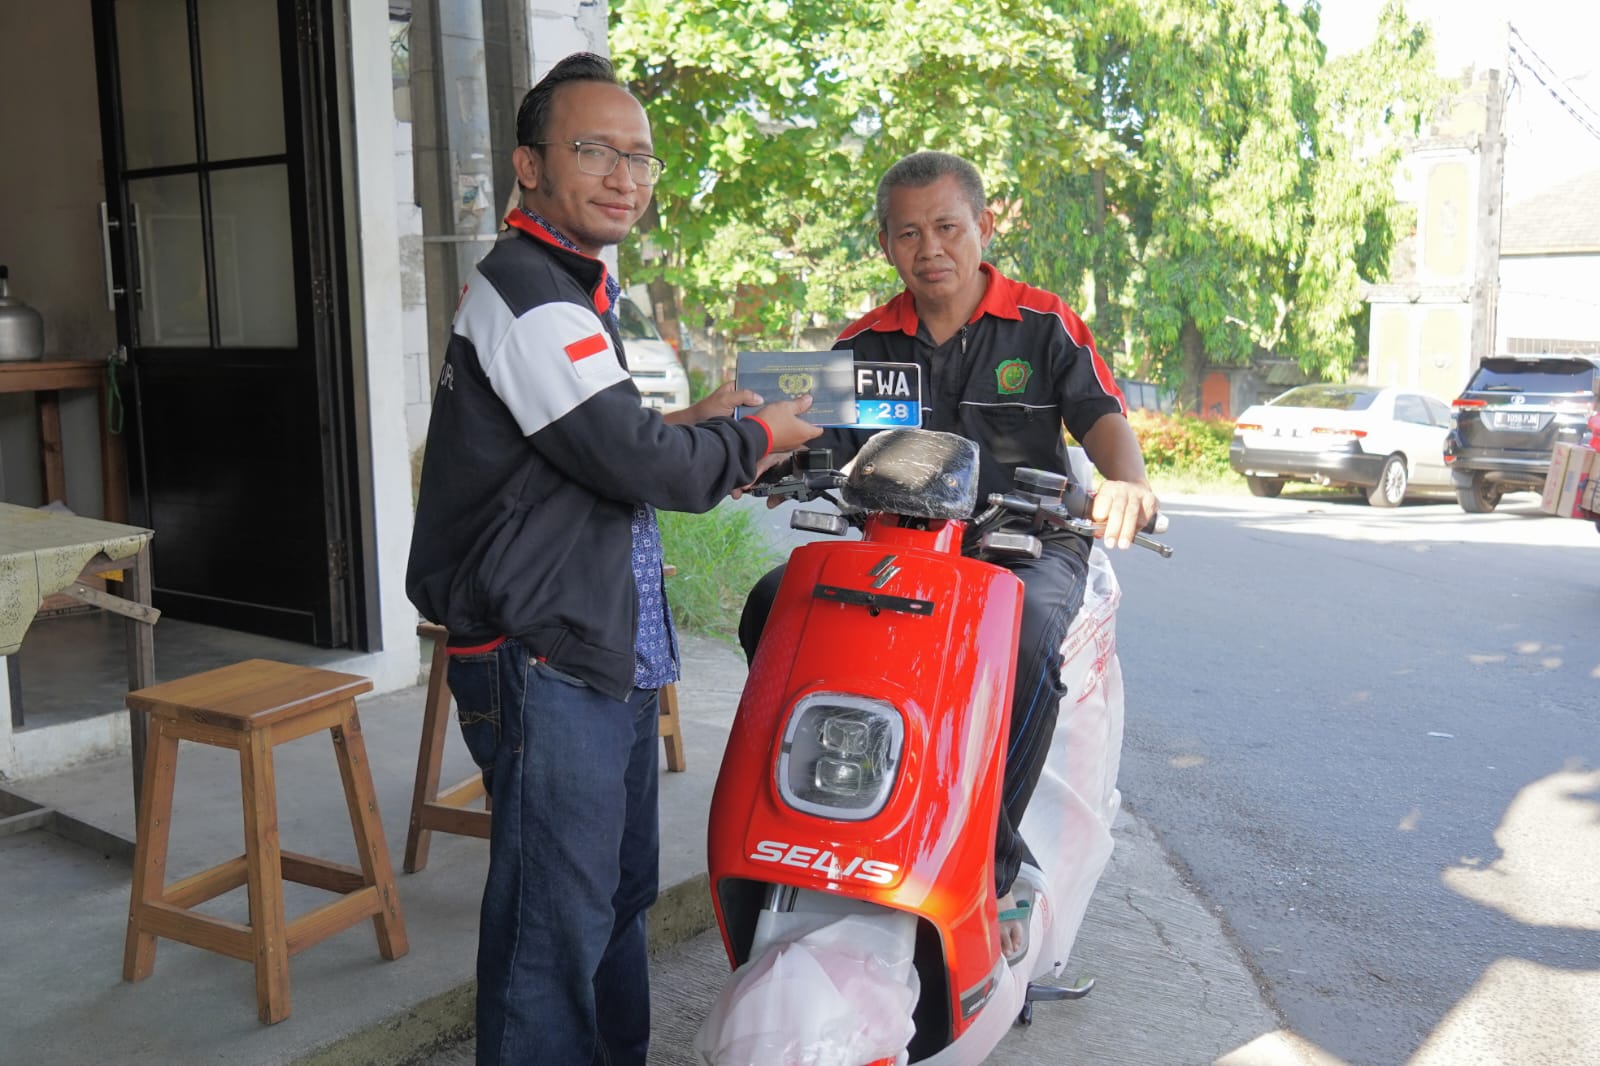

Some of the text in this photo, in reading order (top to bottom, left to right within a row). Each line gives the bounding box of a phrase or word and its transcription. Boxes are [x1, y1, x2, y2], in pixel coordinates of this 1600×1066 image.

[857, 369, 910, 397] FWA
[878, 402, 909, 418] 28
[750, 840, 900, 885] SELIS
